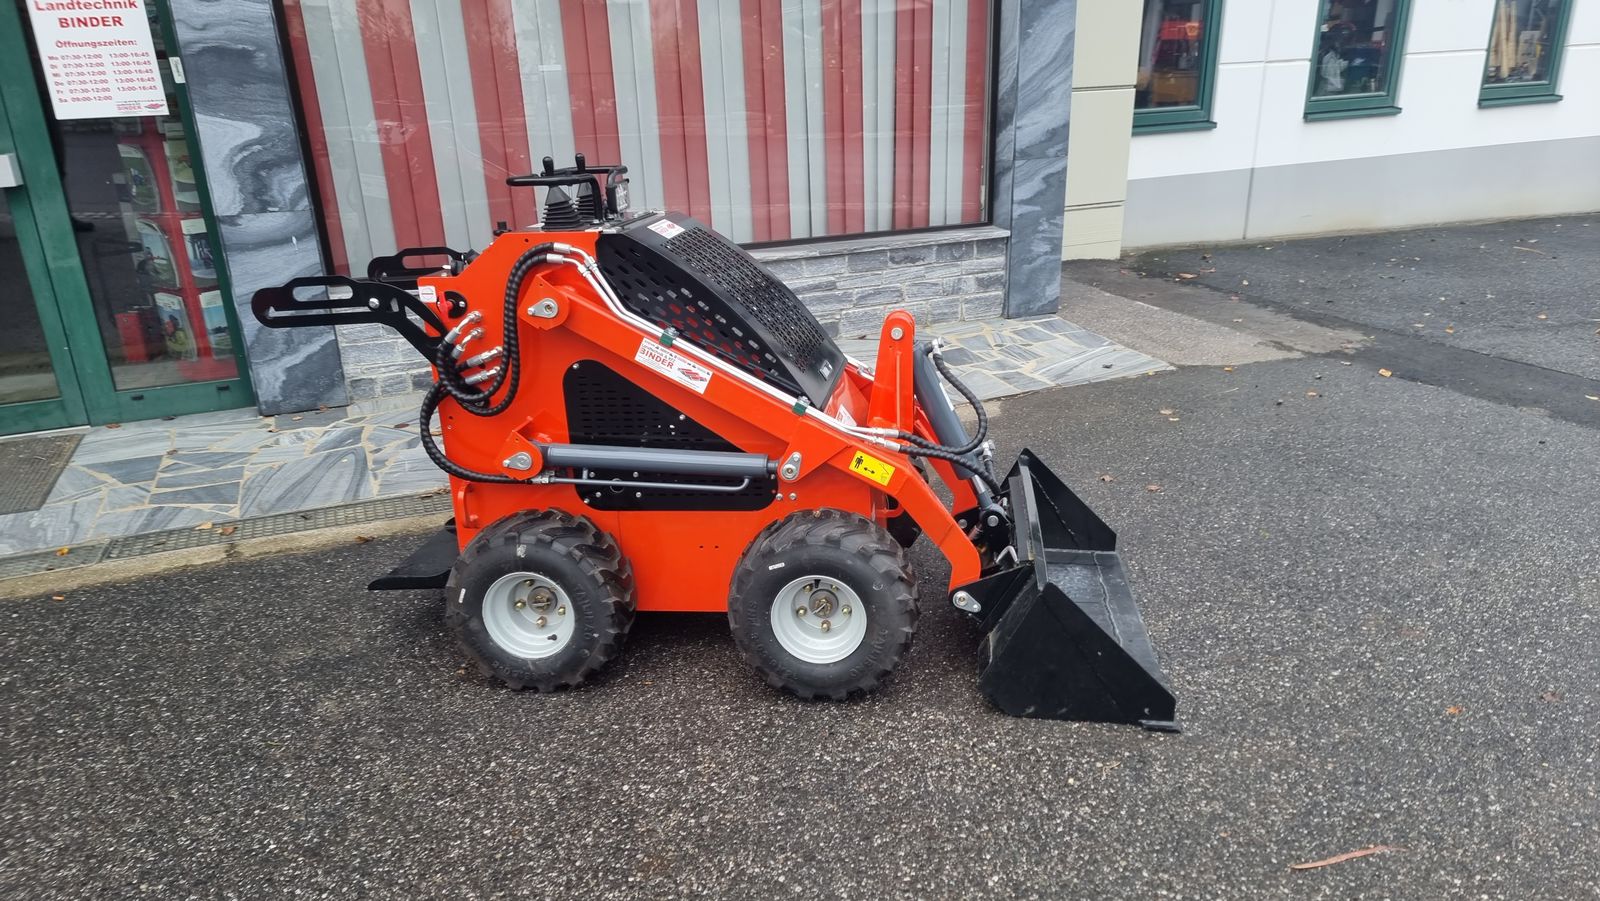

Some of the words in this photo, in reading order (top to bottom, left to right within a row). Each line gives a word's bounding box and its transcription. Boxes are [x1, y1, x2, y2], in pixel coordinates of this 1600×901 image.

[35, 0, 138, 11] Landtechnik
[59, 16, 124, 28] BINDER
[55, 40, 137, 49] Öffnungszeiten:
[61, 53, 103, 61] 07:30-12:00
[109, 51, 150, 59] 13:00-16:45
[640, 347, 674, 370] BINDER
